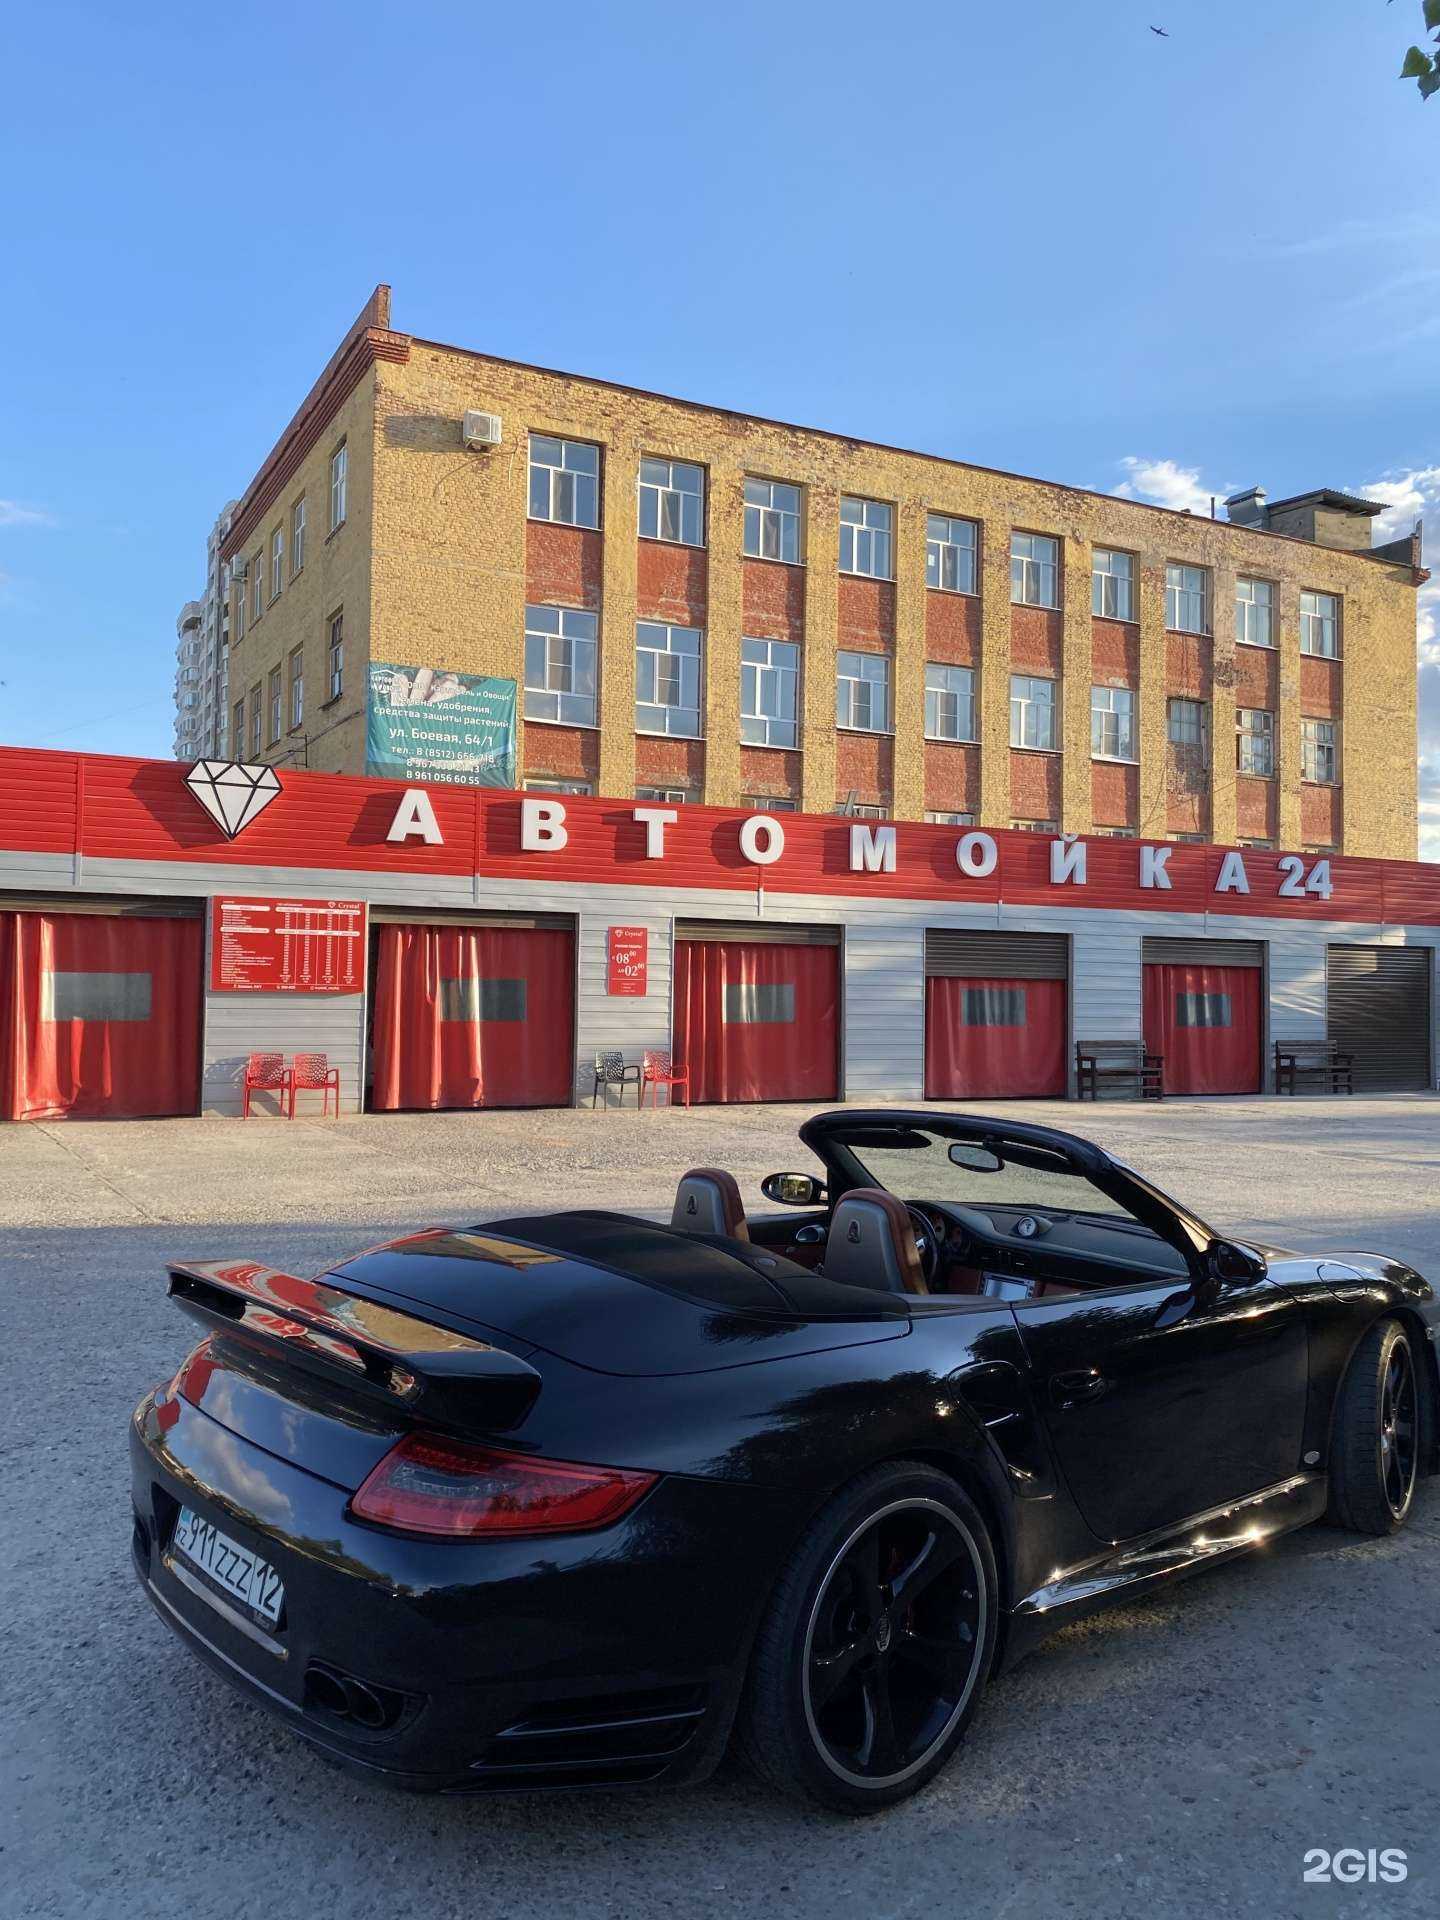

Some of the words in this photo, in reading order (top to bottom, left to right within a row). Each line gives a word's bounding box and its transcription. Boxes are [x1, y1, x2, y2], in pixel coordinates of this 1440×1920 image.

[374, 706, 420, 718] средства
[422, 713, 462, 723] защиты
[389, 727, 408, 739] ул.
[411, 728, 462, 744] Боевая,
[465, 734, 493, 747] 64/1
[425, 748, 455, 760] (8512)
[406, 770, 413, 779] 8
[415, 771, 432, 780] 961
[434, 773, 452, 782] 056
[454, 775, 467, 784] 60
[468, 776, 480, 785] 55
[1278, 856, 1335, 900] 24
[616, 952, 630, 965] 08
[624, 965, 639, 977] 02
